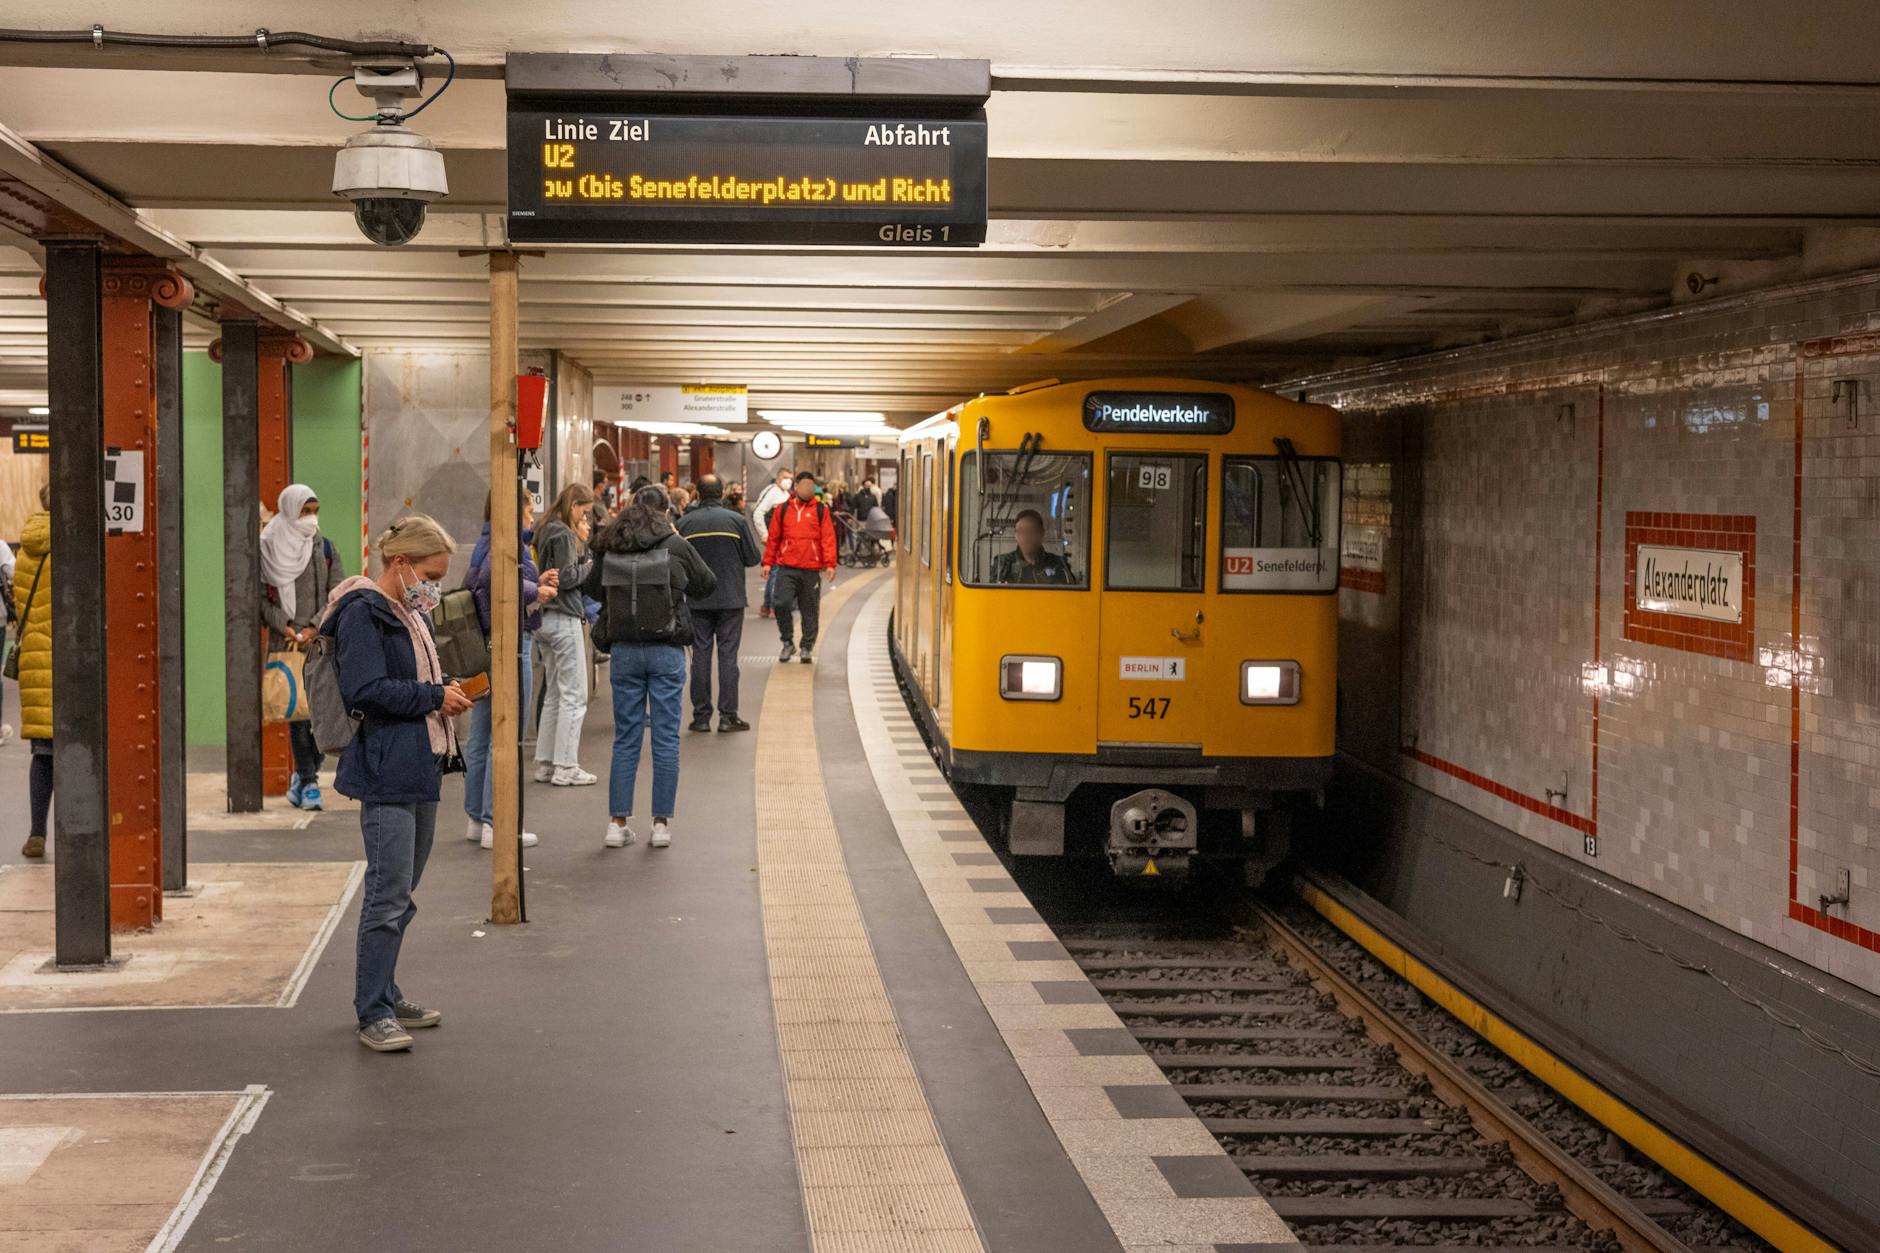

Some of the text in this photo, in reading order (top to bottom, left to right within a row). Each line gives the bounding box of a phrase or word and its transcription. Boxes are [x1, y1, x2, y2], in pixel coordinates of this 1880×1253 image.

[545, 118, 650, 141] Linie Ziel
[864, 123, 951, 146] Abfahrt
[544, 144, 575, 168] U2
[578, 174, 624, 198] (bis
[629, 174, 837, 204] Senefelderplatz)
[842, 177, 887, 202] und
[892, 178, 951, 202] Richt
[878, 224, 950, 242] Gleis 1
[1102, 404, 1210, 424] Pendelverkehr
[1142, 471, 1167, 487] 98
[1227, 557, 1251, 573] U2
[1643, 556, 1730, 610] Alexanderplatz
[1124, 663, 1160, 673] BERLIN
[1128, 696, 1172, 720] 547
[1585, 836, 1596, 856] 13
